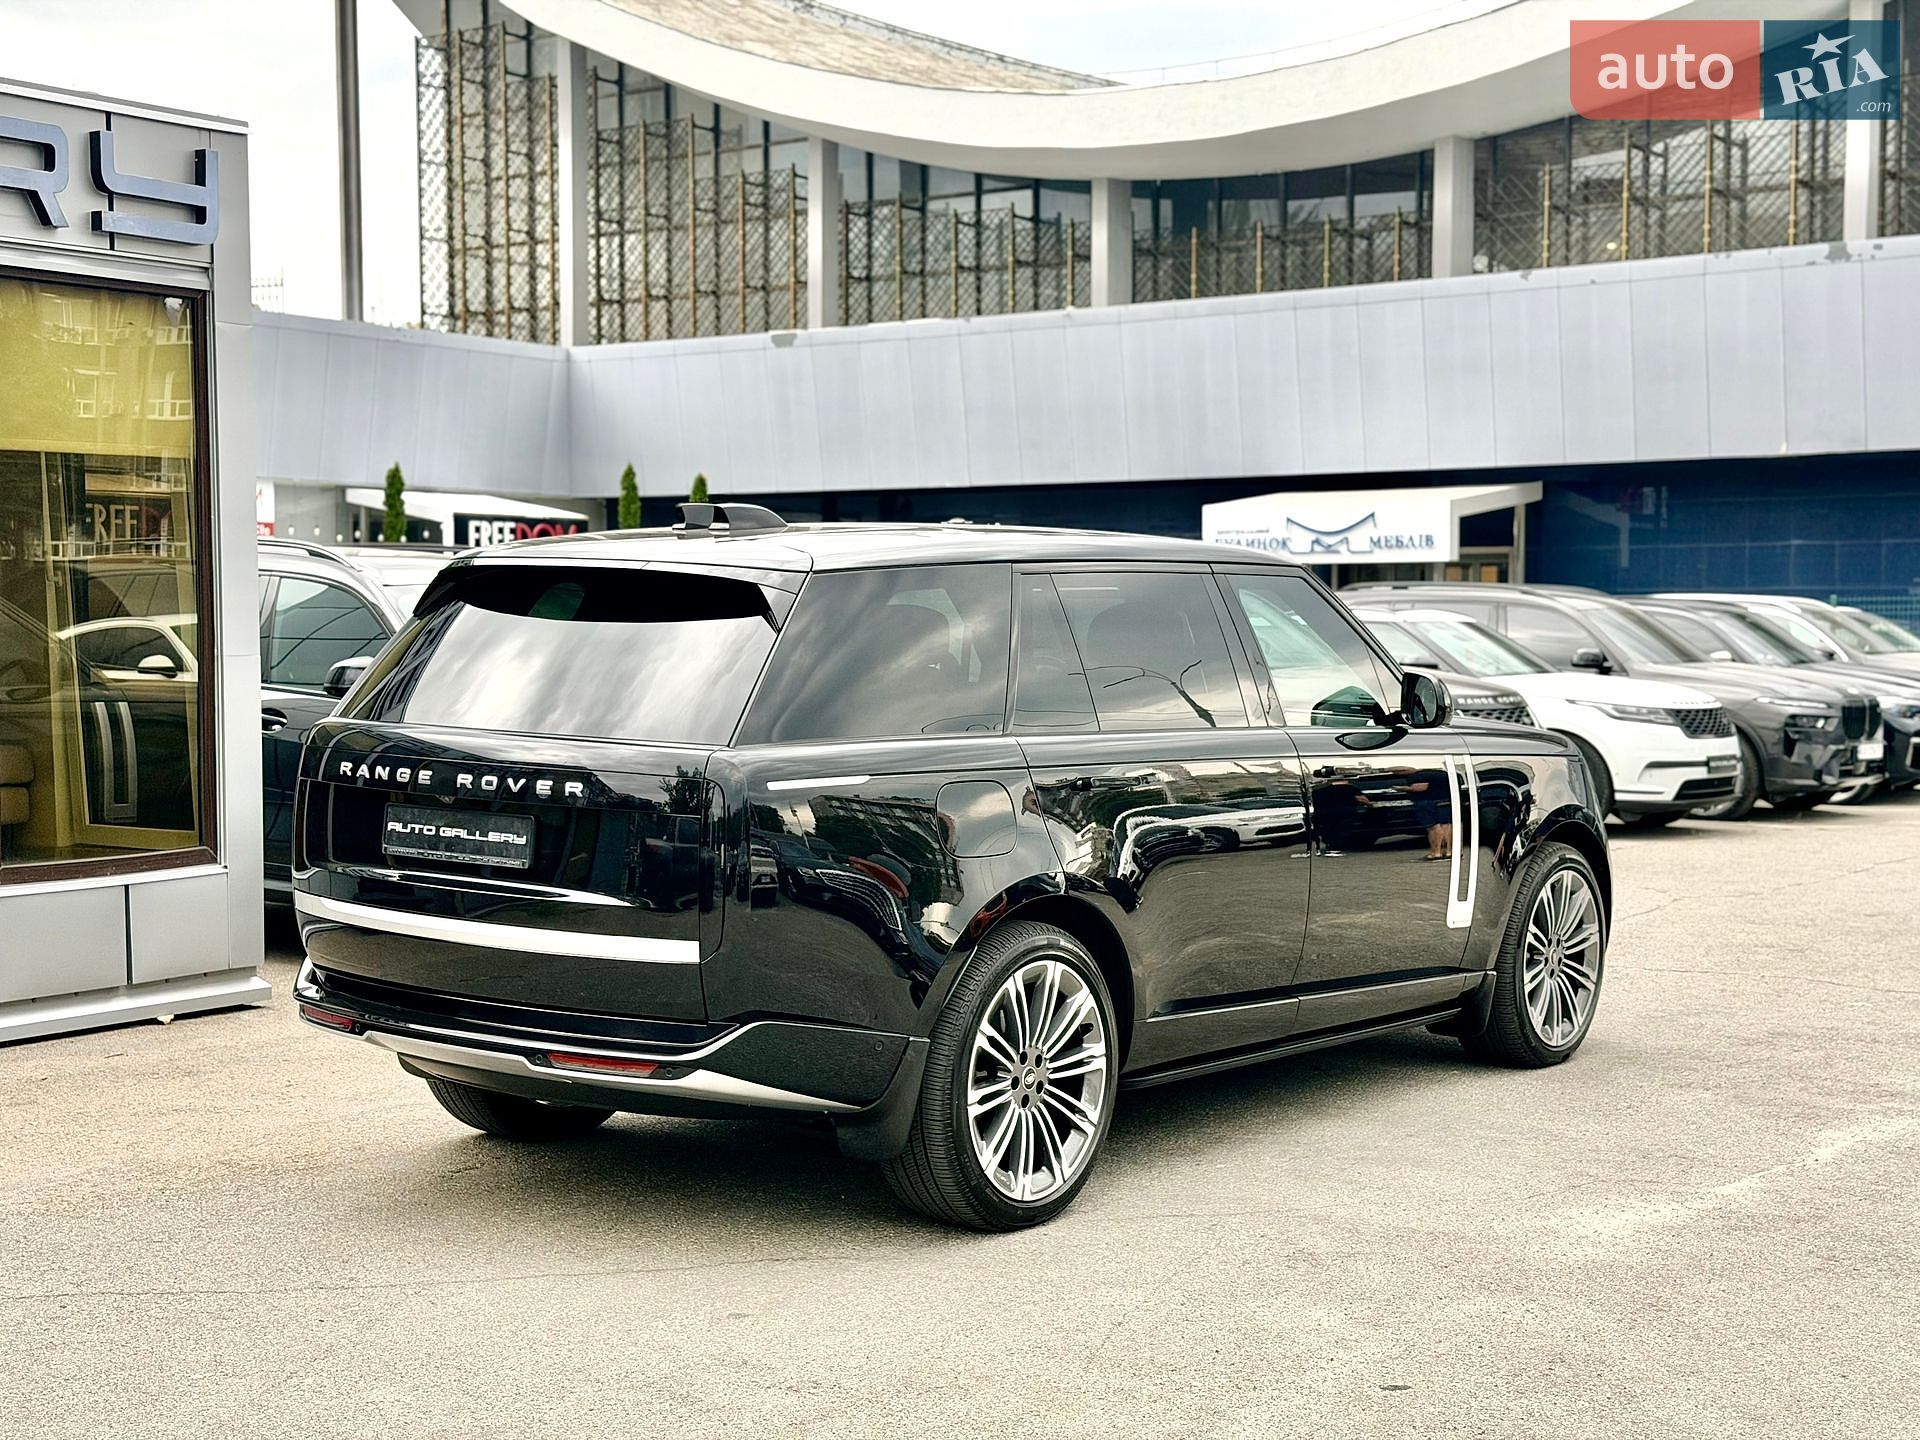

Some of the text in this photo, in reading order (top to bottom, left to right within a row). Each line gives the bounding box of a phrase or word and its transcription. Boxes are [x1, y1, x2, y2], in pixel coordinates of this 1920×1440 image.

[340, 761, 584, 798] RANGE ROVER
[387, 821, 527, 845] AUTO GALLERY
